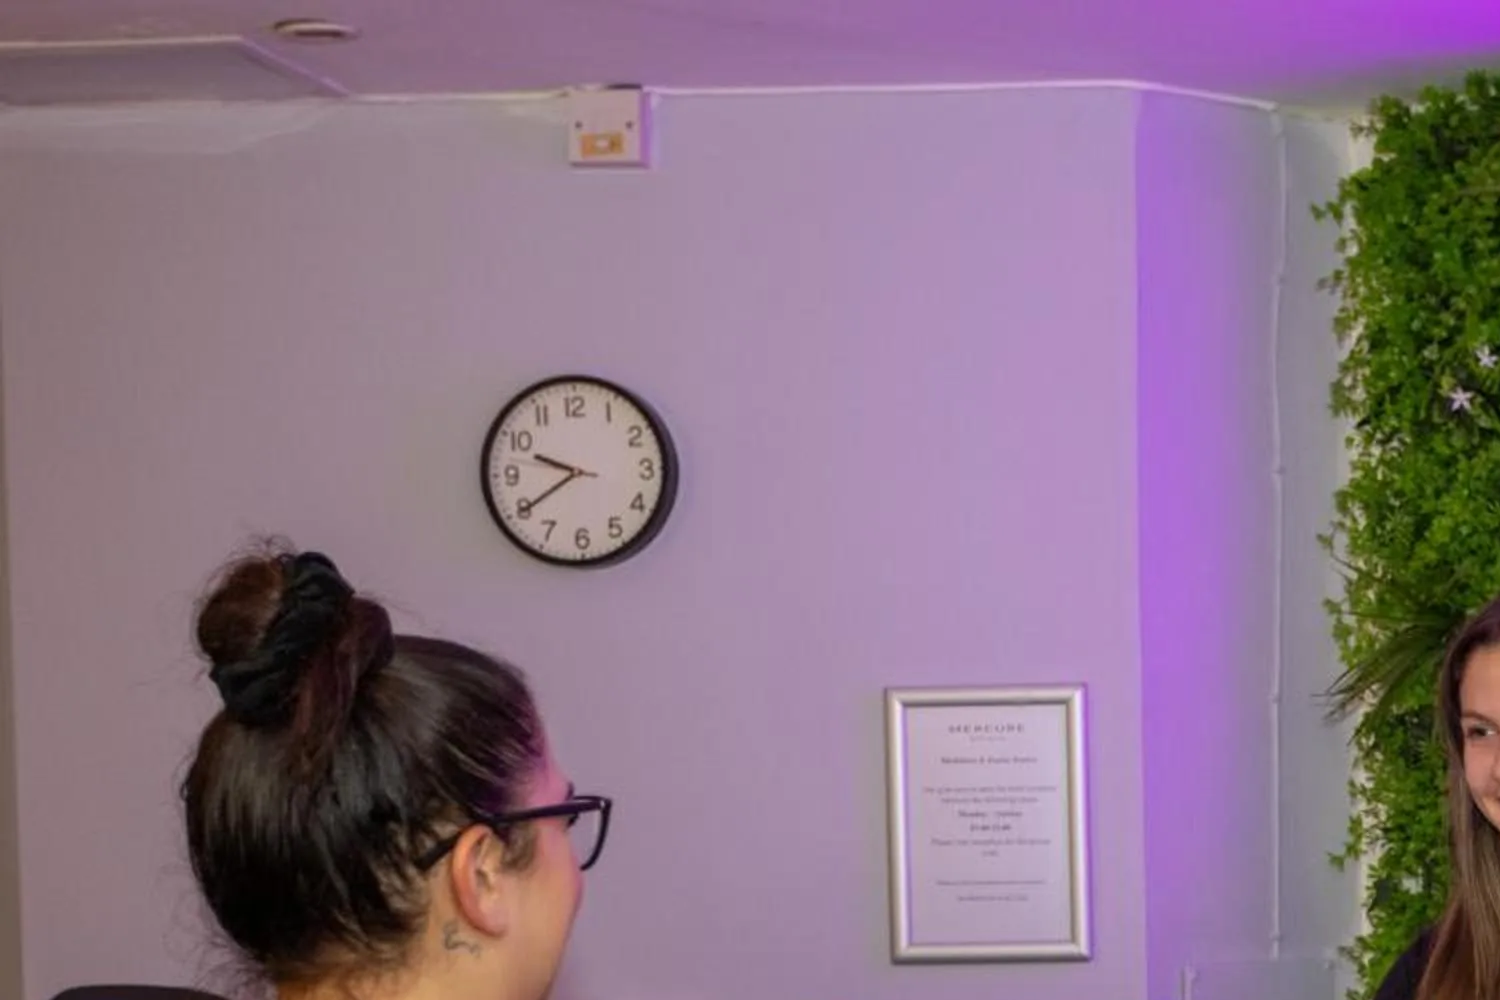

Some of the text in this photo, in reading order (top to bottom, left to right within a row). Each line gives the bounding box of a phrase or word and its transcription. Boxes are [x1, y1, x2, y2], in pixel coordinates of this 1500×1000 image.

[535, 404, 549, 427] 11
[563, 396, 585, 418] 12
[605, 401, 612, 424] 1
[510, 430, 533, 452] 10
[627, 425, 644, 449] 2
[504, 465, 520, 487] 9
[638, 458, 655, 481] 3
[516, 497, 532, 520] 8
[629, 492, 645, 513] 4
[541, 520, 557, 542] 7
[608, 516, 623, 539] 5
[574, 528, 590, 550] 6
